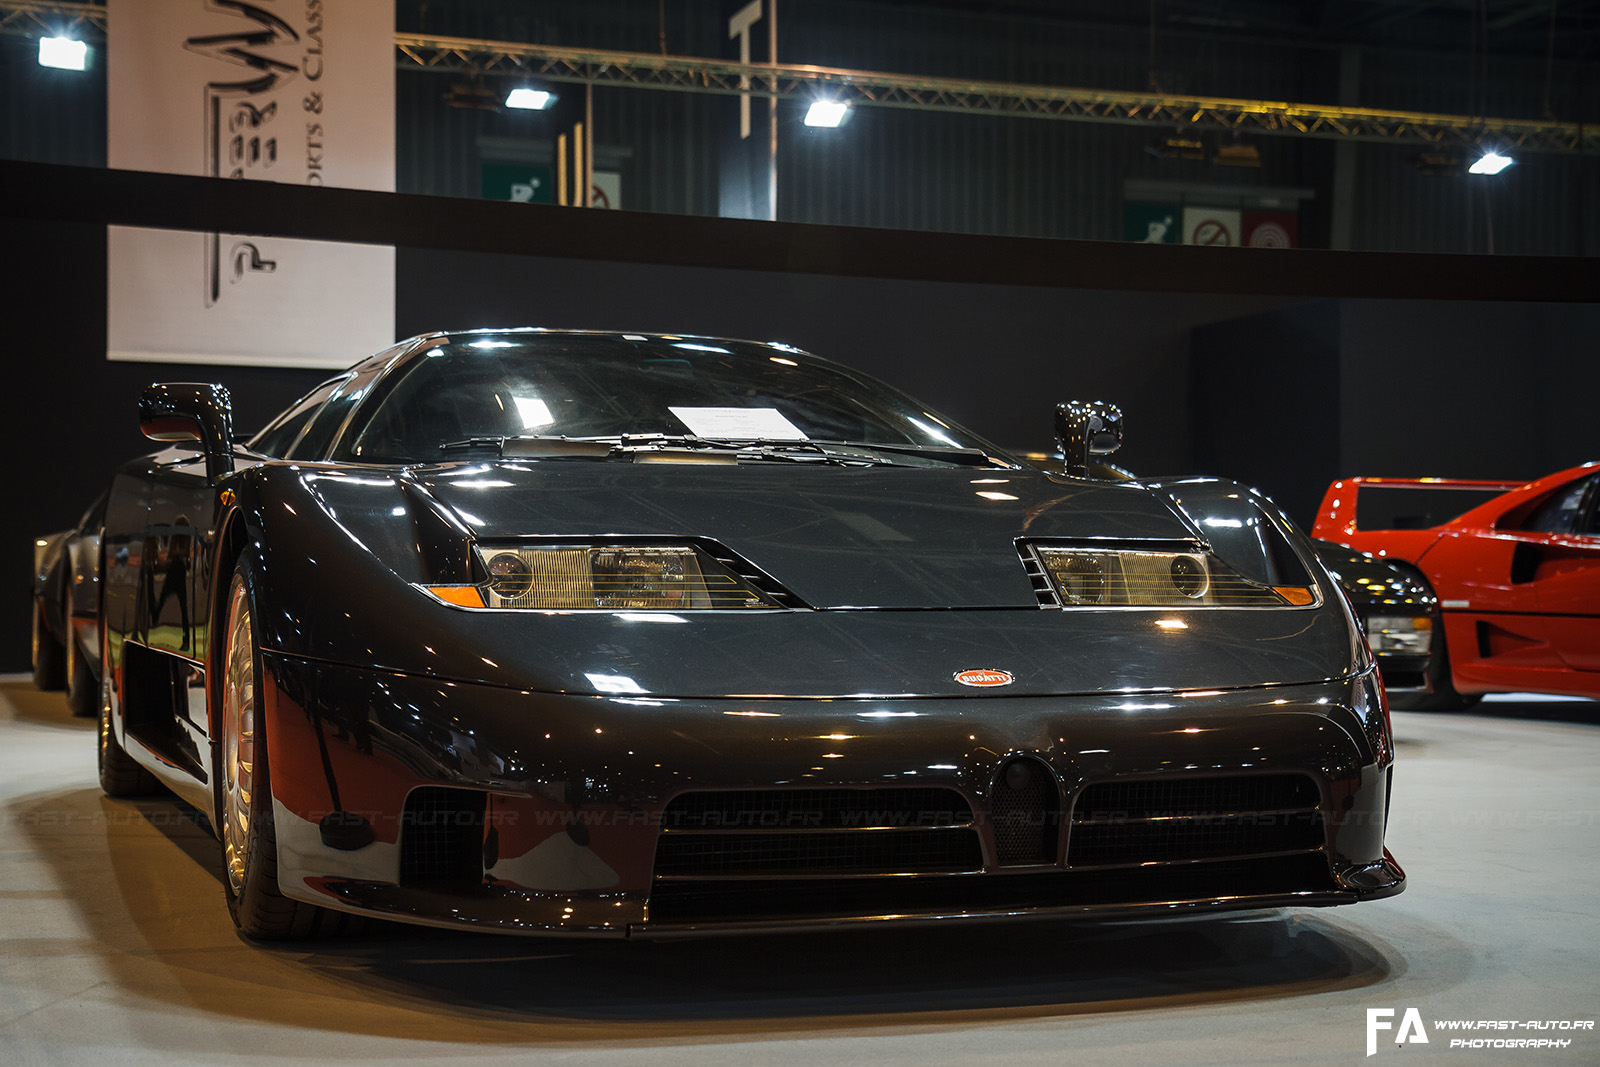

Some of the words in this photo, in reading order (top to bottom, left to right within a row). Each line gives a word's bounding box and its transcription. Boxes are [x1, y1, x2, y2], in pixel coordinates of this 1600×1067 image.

[302, 92, 324, 115] &
[305, 123, 323, 188] ORTS
[961, 674, 1007, 683] BUGATTI
